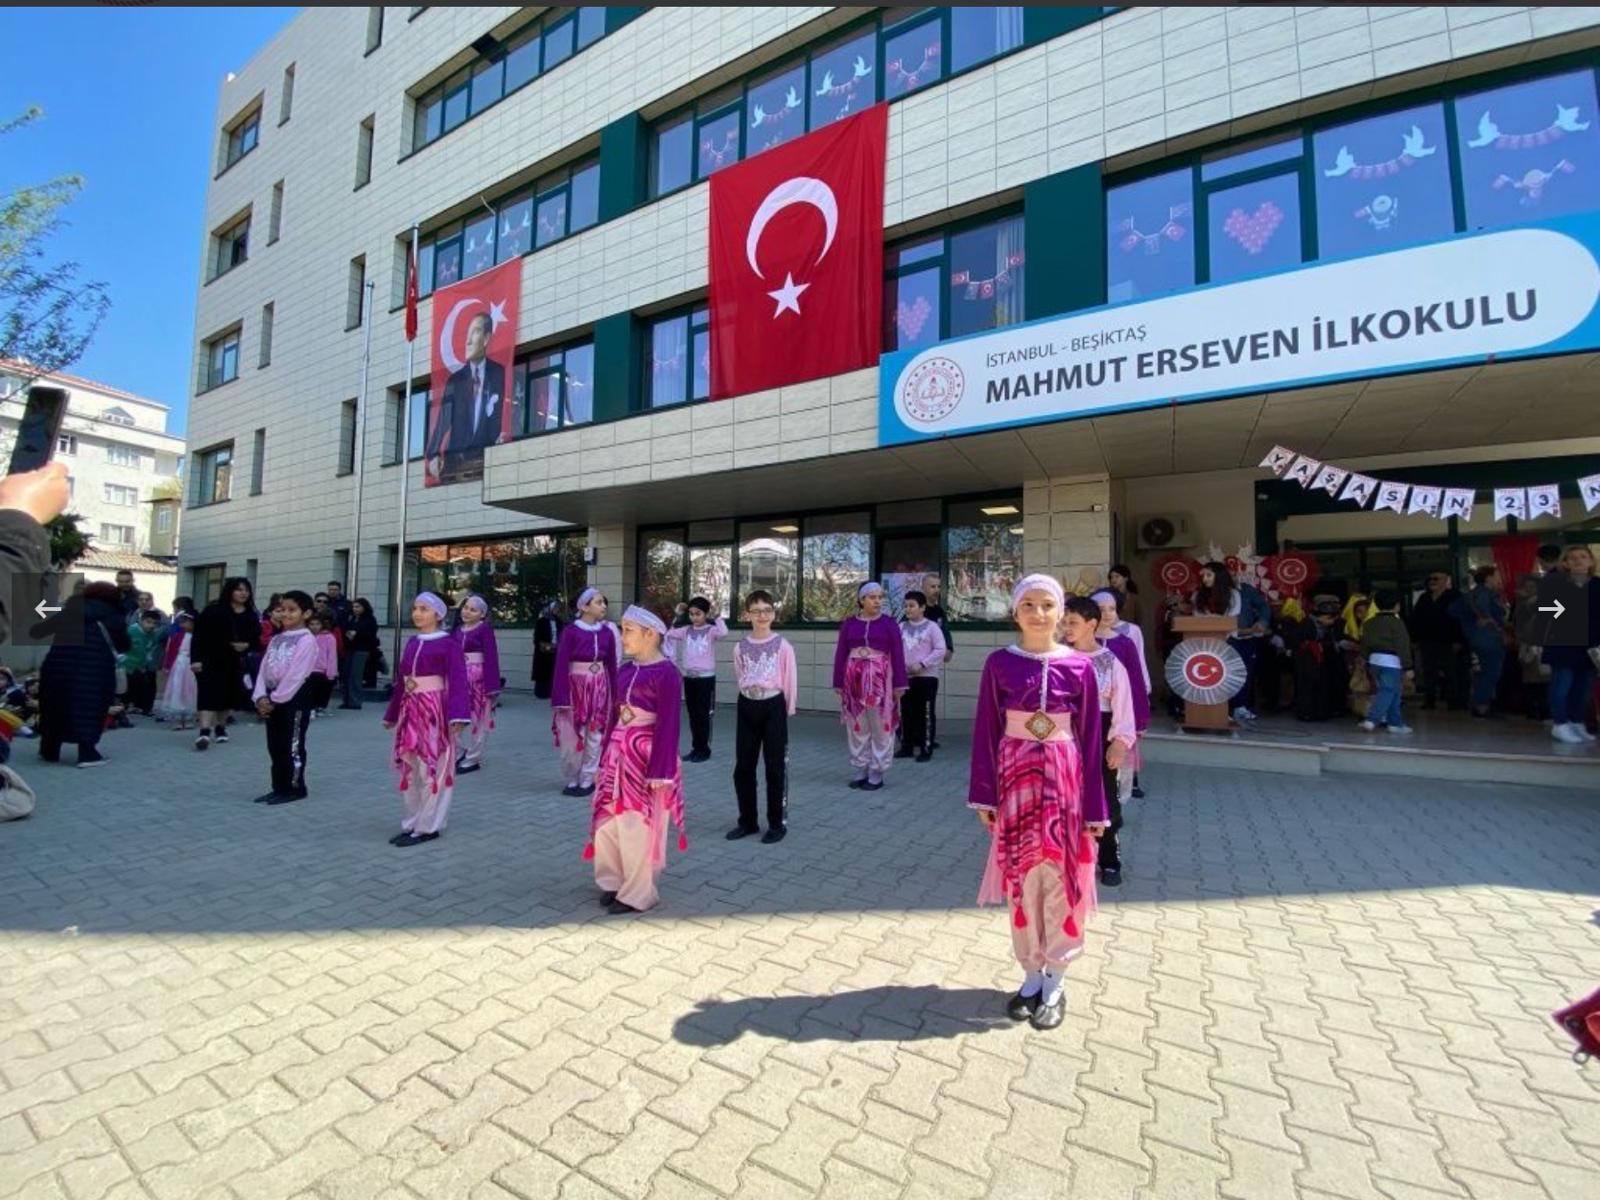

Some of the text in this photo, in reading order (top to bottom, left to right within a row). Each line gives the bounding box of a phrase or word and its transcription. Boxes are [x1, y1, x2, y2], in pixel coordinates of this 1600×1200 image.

[986, 356, 1127, 403] MAHMUT
[1136, 327, 1299, 378] ERSEVEN
[1312, 288, 1536, 350] İLKOKULU
[986, 344, 1058, 368] İSTANBUL
[1071, 325, 1147, 352] BEŞİKTAŞ
[1273, 454, 1465, 509] YAŞASIN
[1504, 494, 1550, 508] 23
